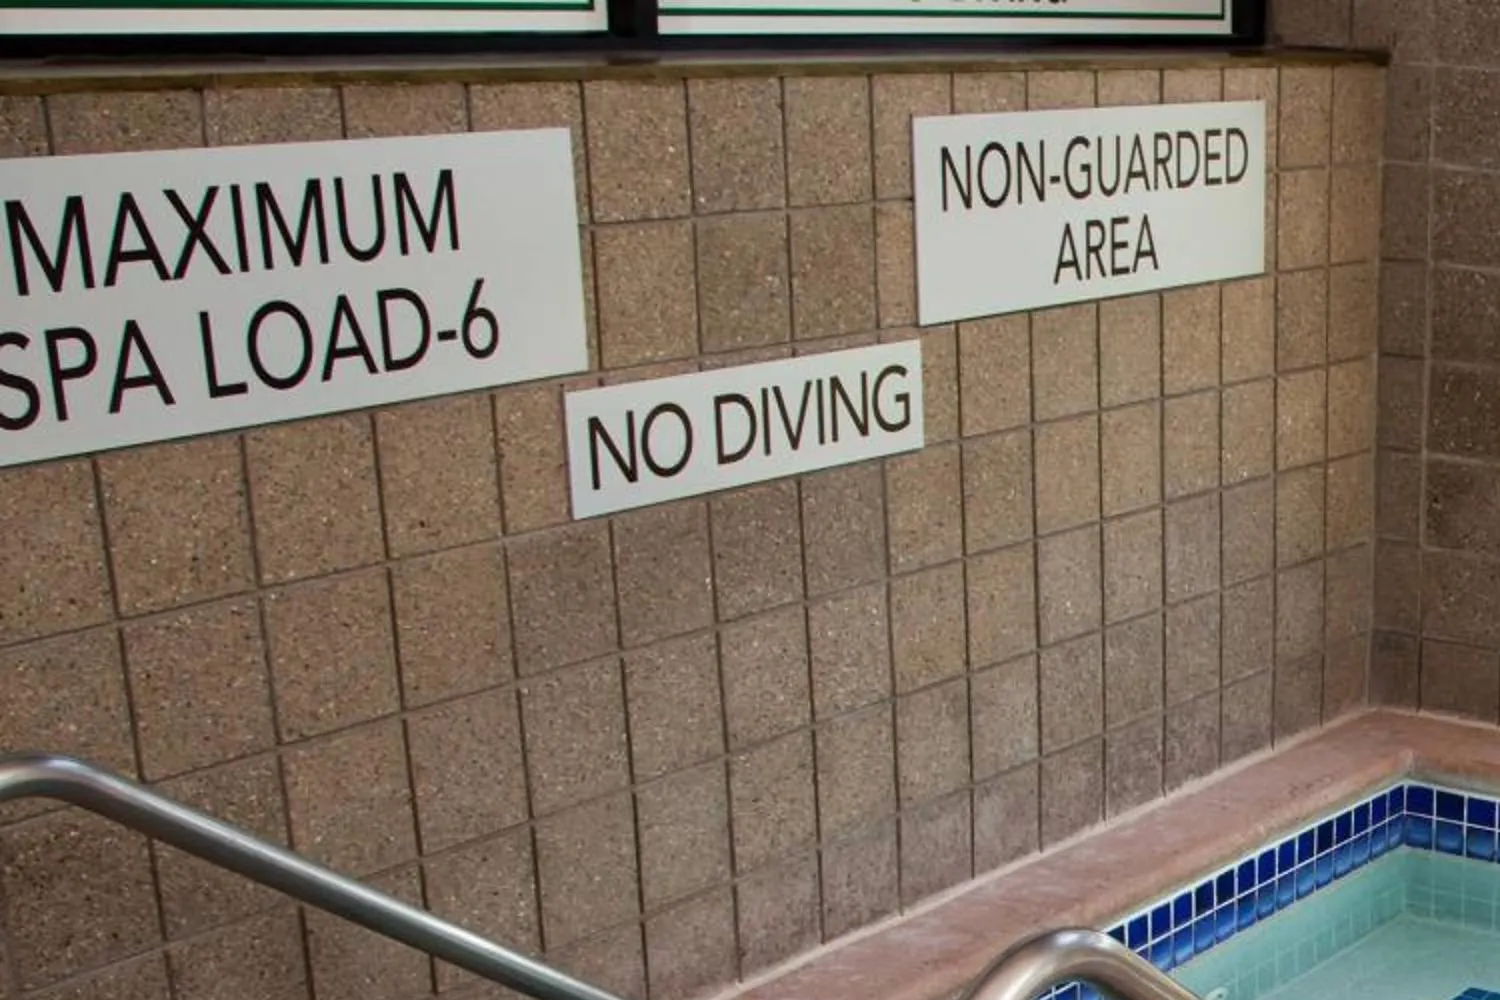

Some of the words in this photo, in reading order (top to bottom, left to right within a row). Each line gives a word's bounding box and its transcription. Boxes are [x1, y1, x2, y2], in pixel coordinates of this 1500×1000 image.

[939, 126, 1249, 212] NON-GUARDED
[4, 168, 461, 297] MAXIMUM
[1053, 213, 1159, 285] AREA
[0, 319, 176, 431] SPA
[199, 277, 500, 399] LOAD-6
[587, 401, 694, 490] NO
[713, 364, 911, 465] DIVING
